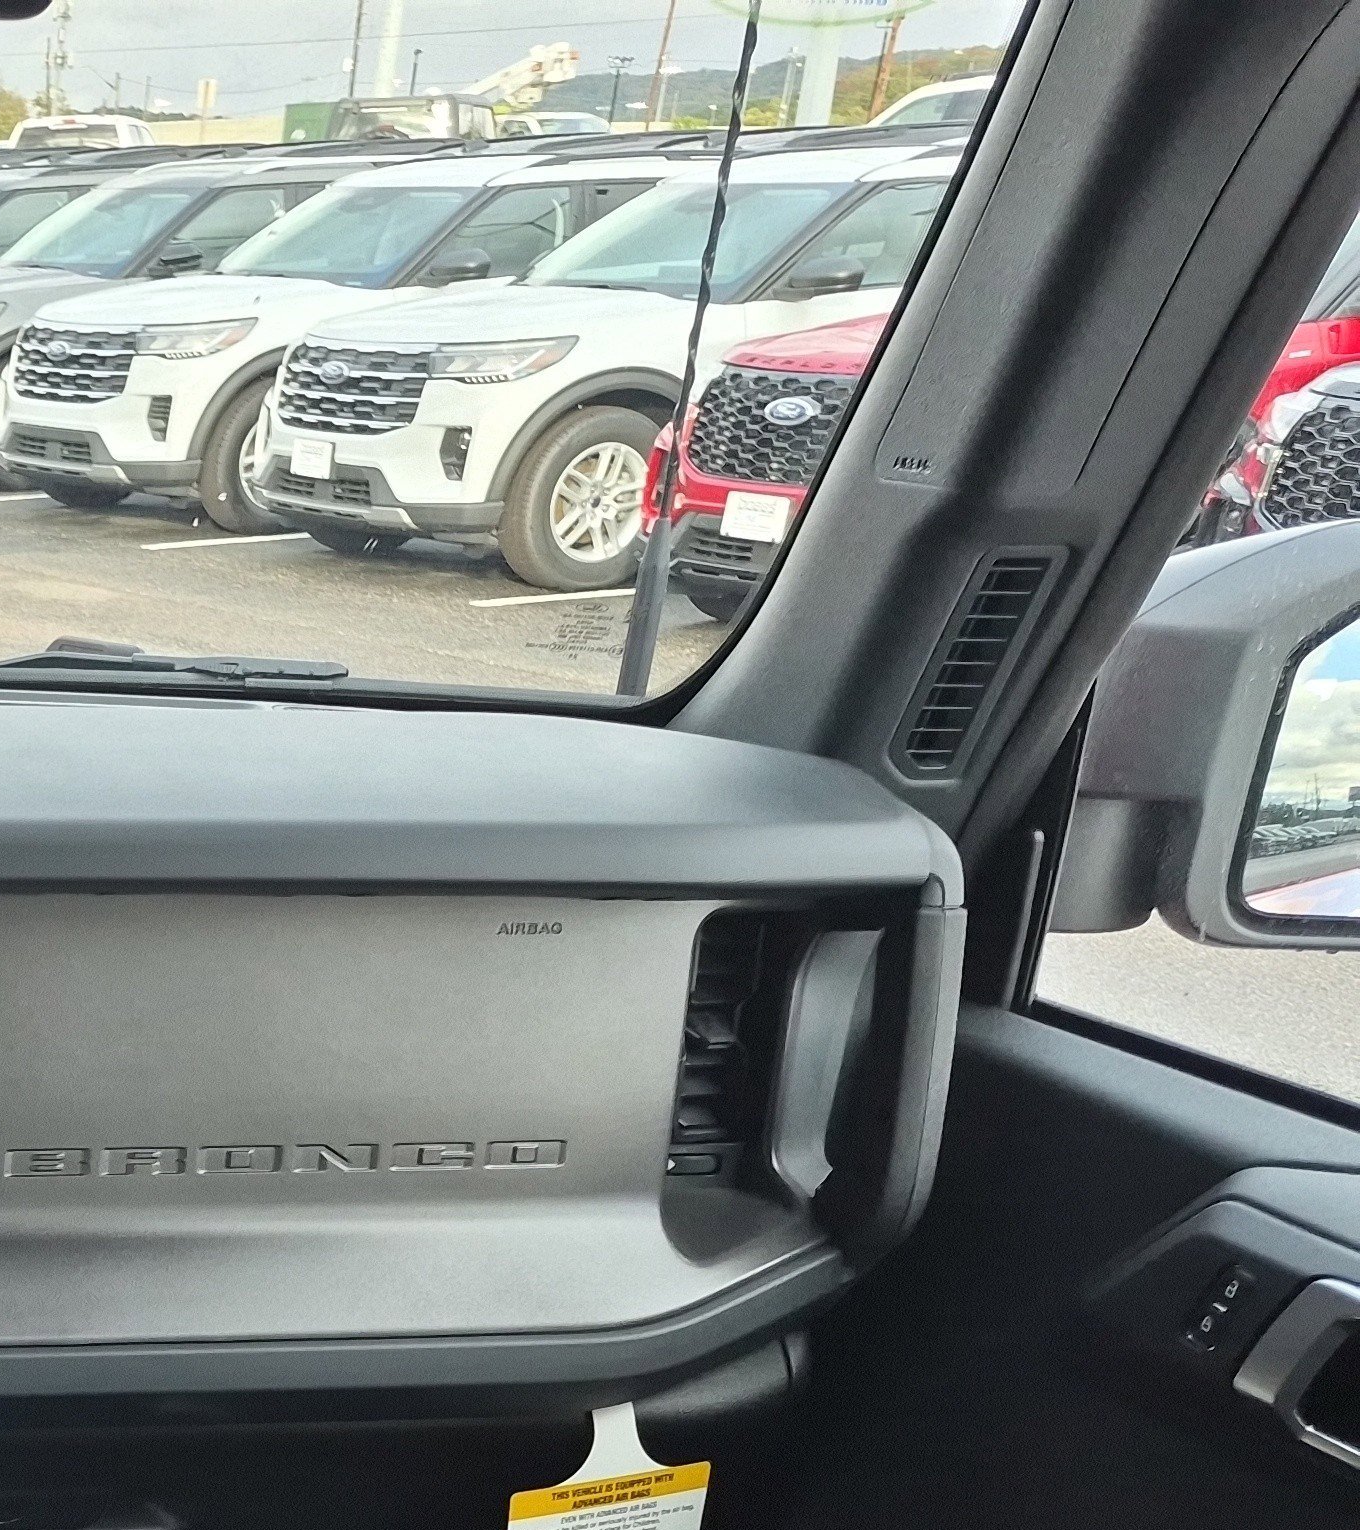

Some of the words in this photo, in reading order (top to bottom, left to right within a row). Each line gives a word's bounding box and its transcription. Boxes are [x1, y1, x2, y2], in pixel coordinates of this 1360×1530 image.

[3, 1139, 567, 1178] BRONCO
[552, 1492, 570, 1500] THIS
[606, 1484, 614, 1493] IS
[615, 1476, 652, 1490] EQUIPPED
[654, 1473, 674, 1484] WITH
[572, 1497, 614, 1510] ADVANCED
[630, 1488, 651, 1500] BAGS
